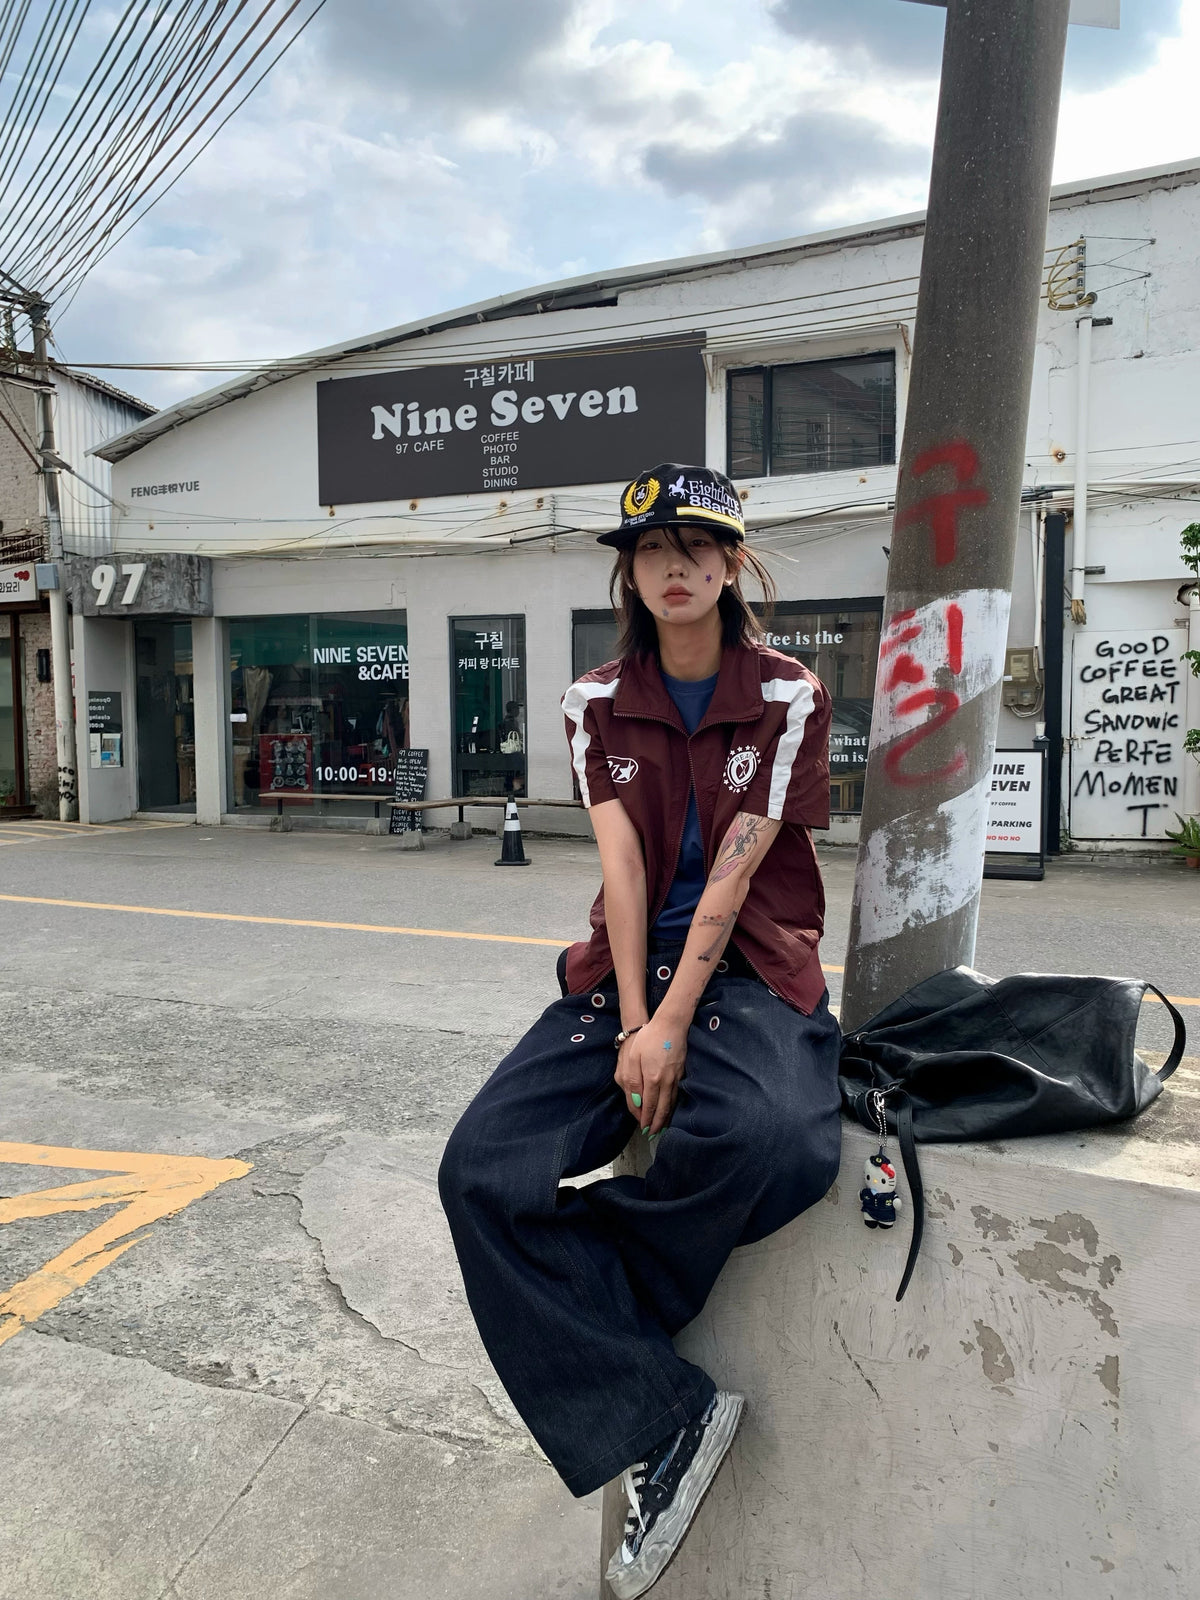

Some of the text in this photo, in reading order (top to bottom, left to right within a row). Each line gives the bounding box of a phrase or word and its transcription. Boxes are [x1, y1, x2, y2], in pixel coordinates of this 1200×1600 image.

[370, 385, 639, 441] Nine Seven
[480, 431, 520, 445] COFFEE
[395, 439, 445, 455] 97 CAFE
[483, 443, 518, 455] PHOTO
[490, 455, 510, 466] BAR
[482, 466, 519, 478] STUDIO
[483, 477, 518, 489] DINING
[91, 562, 148, 607] 97
[474, 631, 504, 651] 구칠
[762, 630, 844, 646] fee is the
[313, 645, 408, 664] NINE SEVEN
[1096, 636, 1170, 658] GOOD
[458, 657, 521, 670] 커피 랑 디저트
[1080, 659, 1177, 683] COFFEE
[358, 664, 410, 681] &CAFE
[1102, 681, 1180, 704] GREAT
[1084, 709, 1179, 734] SANDWIC
[833, 735, 867, 746] what
[991, 820, 1032, 828] PARKING
[1127, 803, 1164, 837] T
